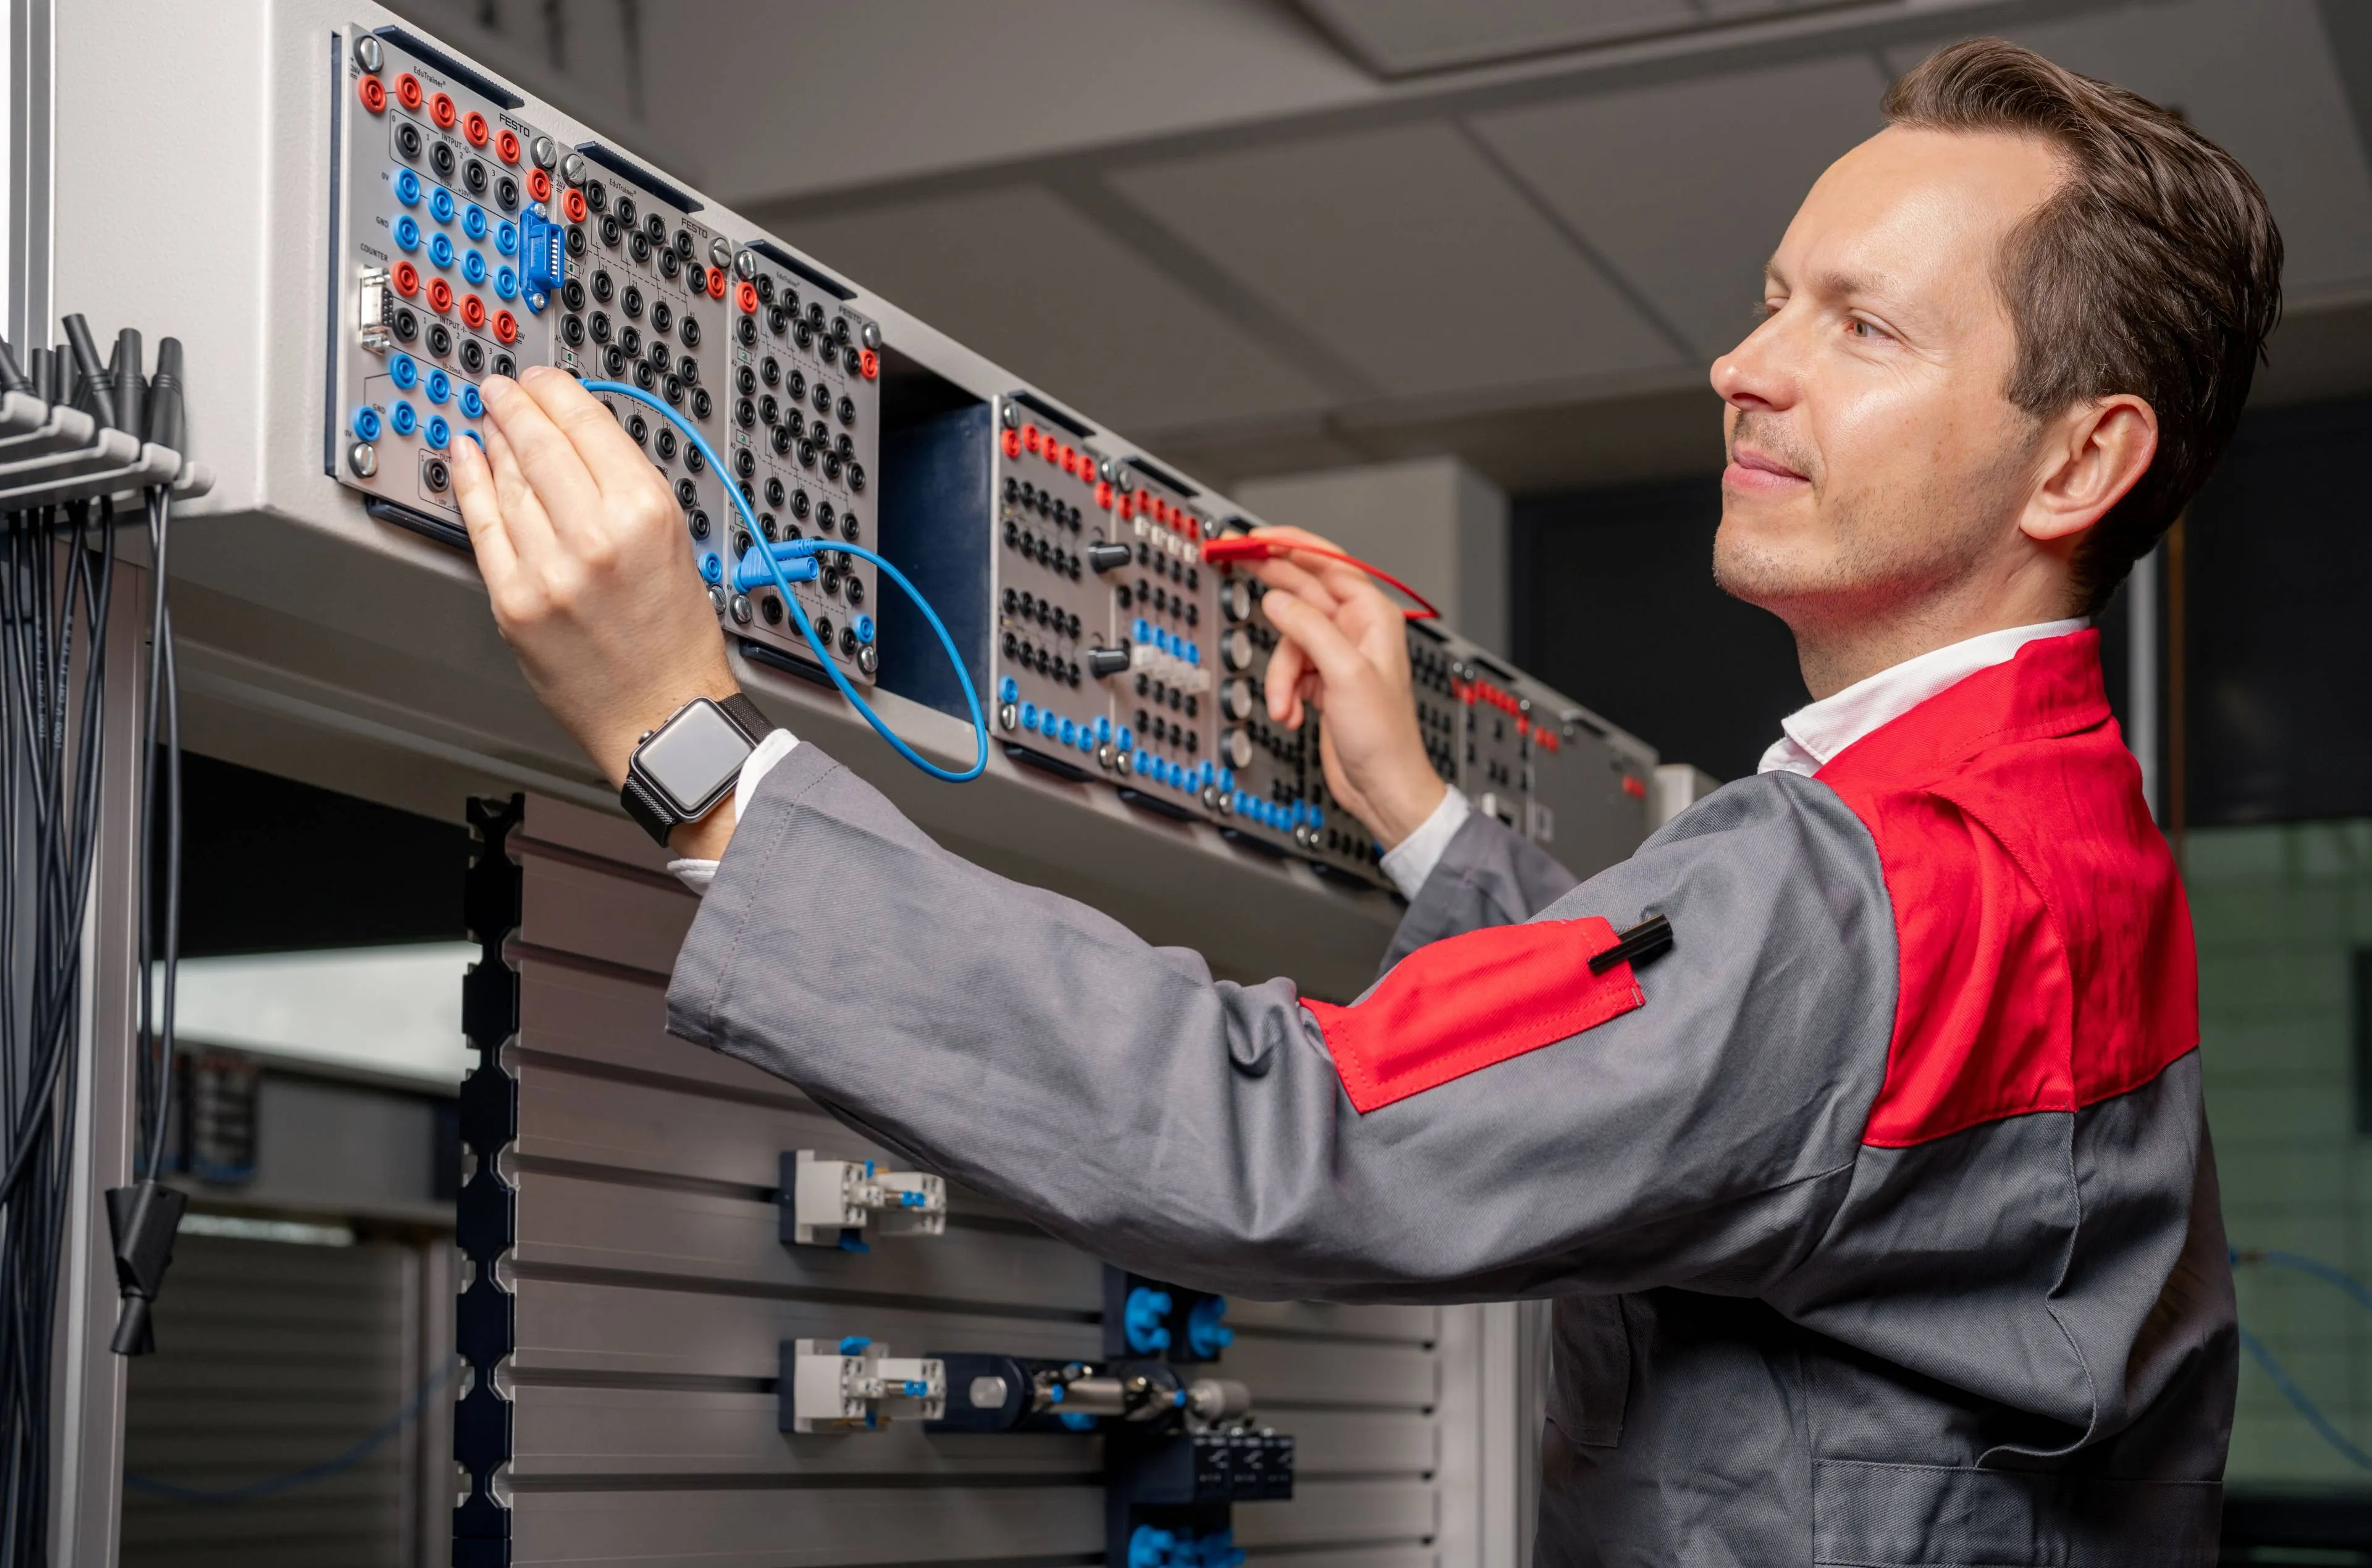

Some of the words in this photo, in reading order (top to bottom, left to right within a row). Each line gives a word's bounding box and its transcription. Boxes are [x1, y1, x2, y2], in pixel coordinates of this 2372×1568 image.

[499, 113, 530, 137] FESTO
[442, 133, 461, 149] INTPUT
[556, 179, 566, 190] 24V
[376, 216, 389, 228] GND
[681, 217, 708, 239] FESTO
[361, 243, 388, 262] COUNTER
[439, 316, 460, 330] INTPUT
[555, 335, 561, 343] A1
[554, 361, 561, 369] A2
[637, 409, 642, 417] 21
[665, 422, 671, 430] 31
[731, 417, 736, 426] A1
[440, 453, 452, 463] OUT
[730, 501, 735, 509] A1
[729, 525, 735, 533] A2
